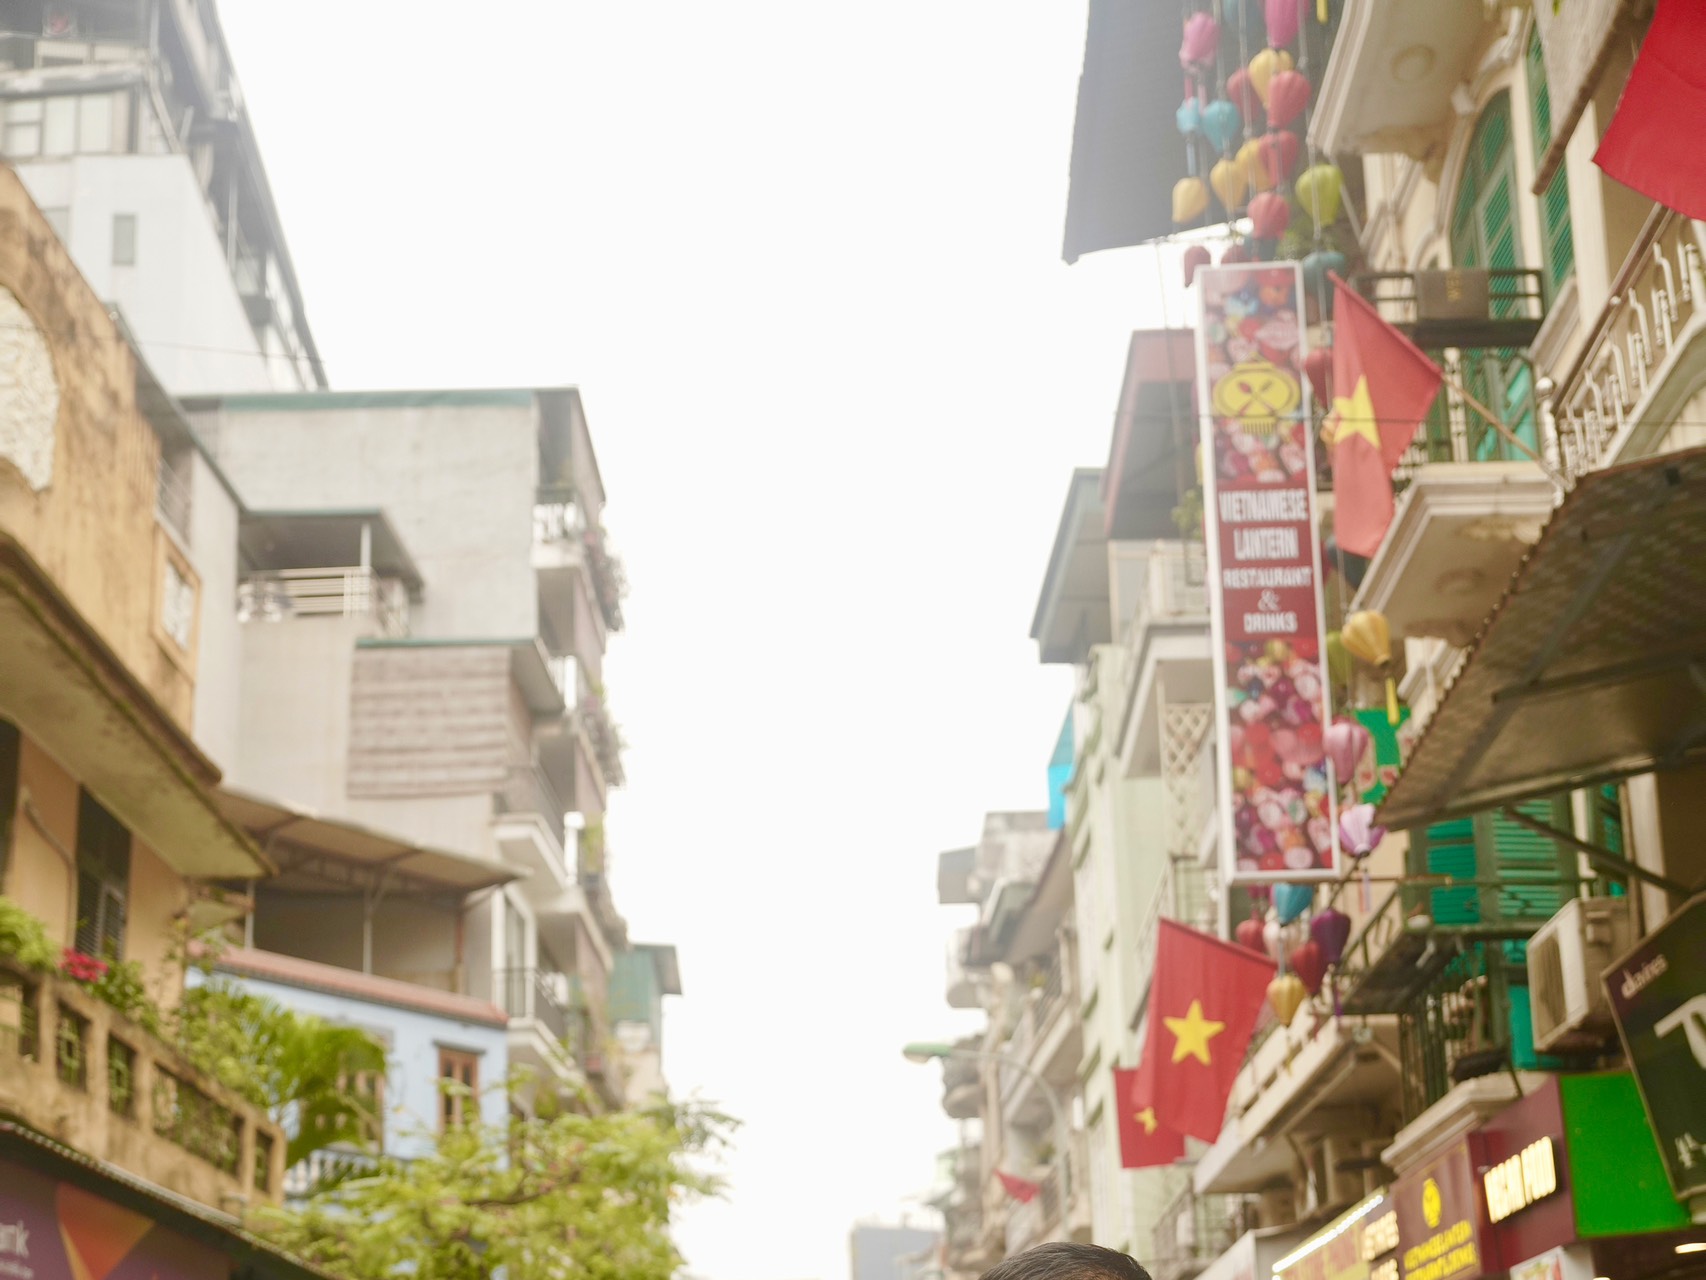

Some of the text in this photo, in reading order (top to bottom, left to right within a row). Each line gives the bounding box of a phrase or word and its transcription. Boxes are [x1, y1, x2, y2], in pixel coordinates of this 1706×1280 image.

[1218, 488, 1308, 522] VIETNAMESE
[1233, 527, 1299, 560] LANTERN
[1223, 566, 1312, 589] RESTAURANT
[1258, 589, 1279, 611] &
[1243, 611, 1298, 633] DRINKS
